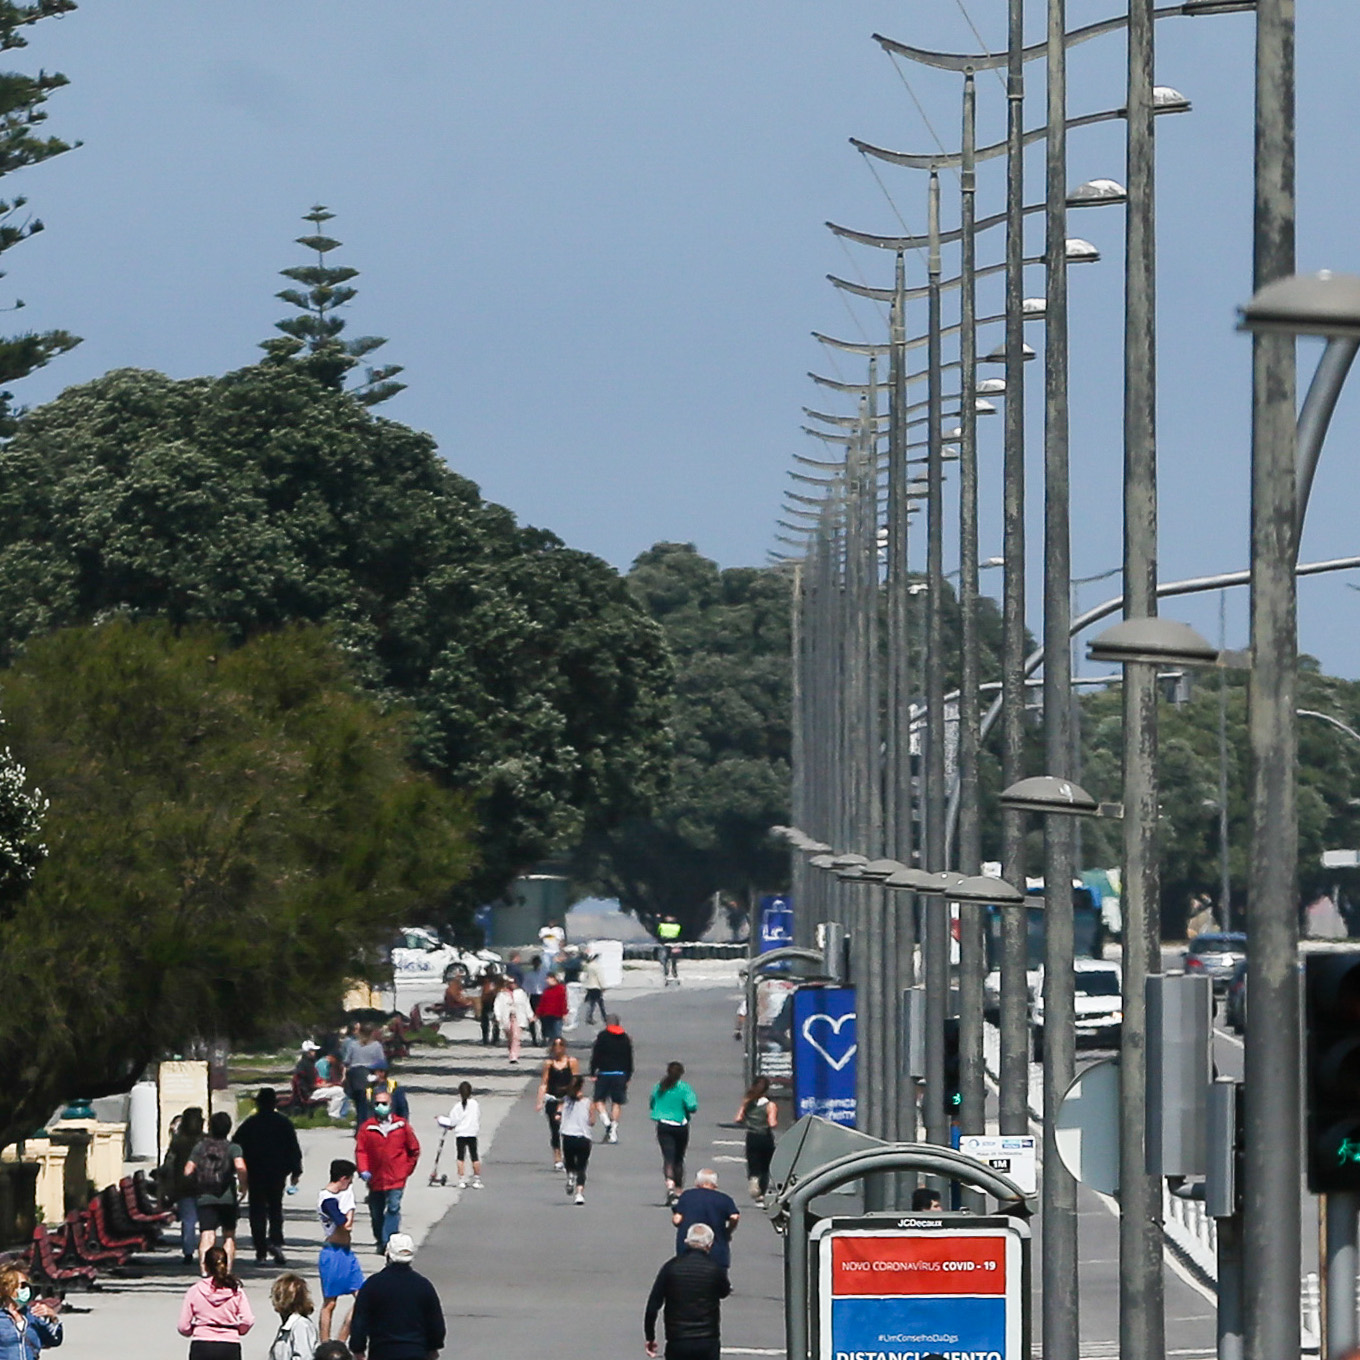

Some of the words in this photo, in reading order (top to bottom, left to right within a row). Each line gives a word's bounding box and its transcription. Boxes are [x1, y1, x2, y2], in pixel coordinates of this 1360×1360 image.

[993, 1160, 1007, 1168] 1M
[897, 1219, 943, 1228] JCDecaux
[842, 1261, 870, 1271] NOVO
[872, 1260, 941, 1271] CORONAVÍRUS
[942, 1261, 975, 1271] COVID
[983, 1261, 997, 1271] 19
